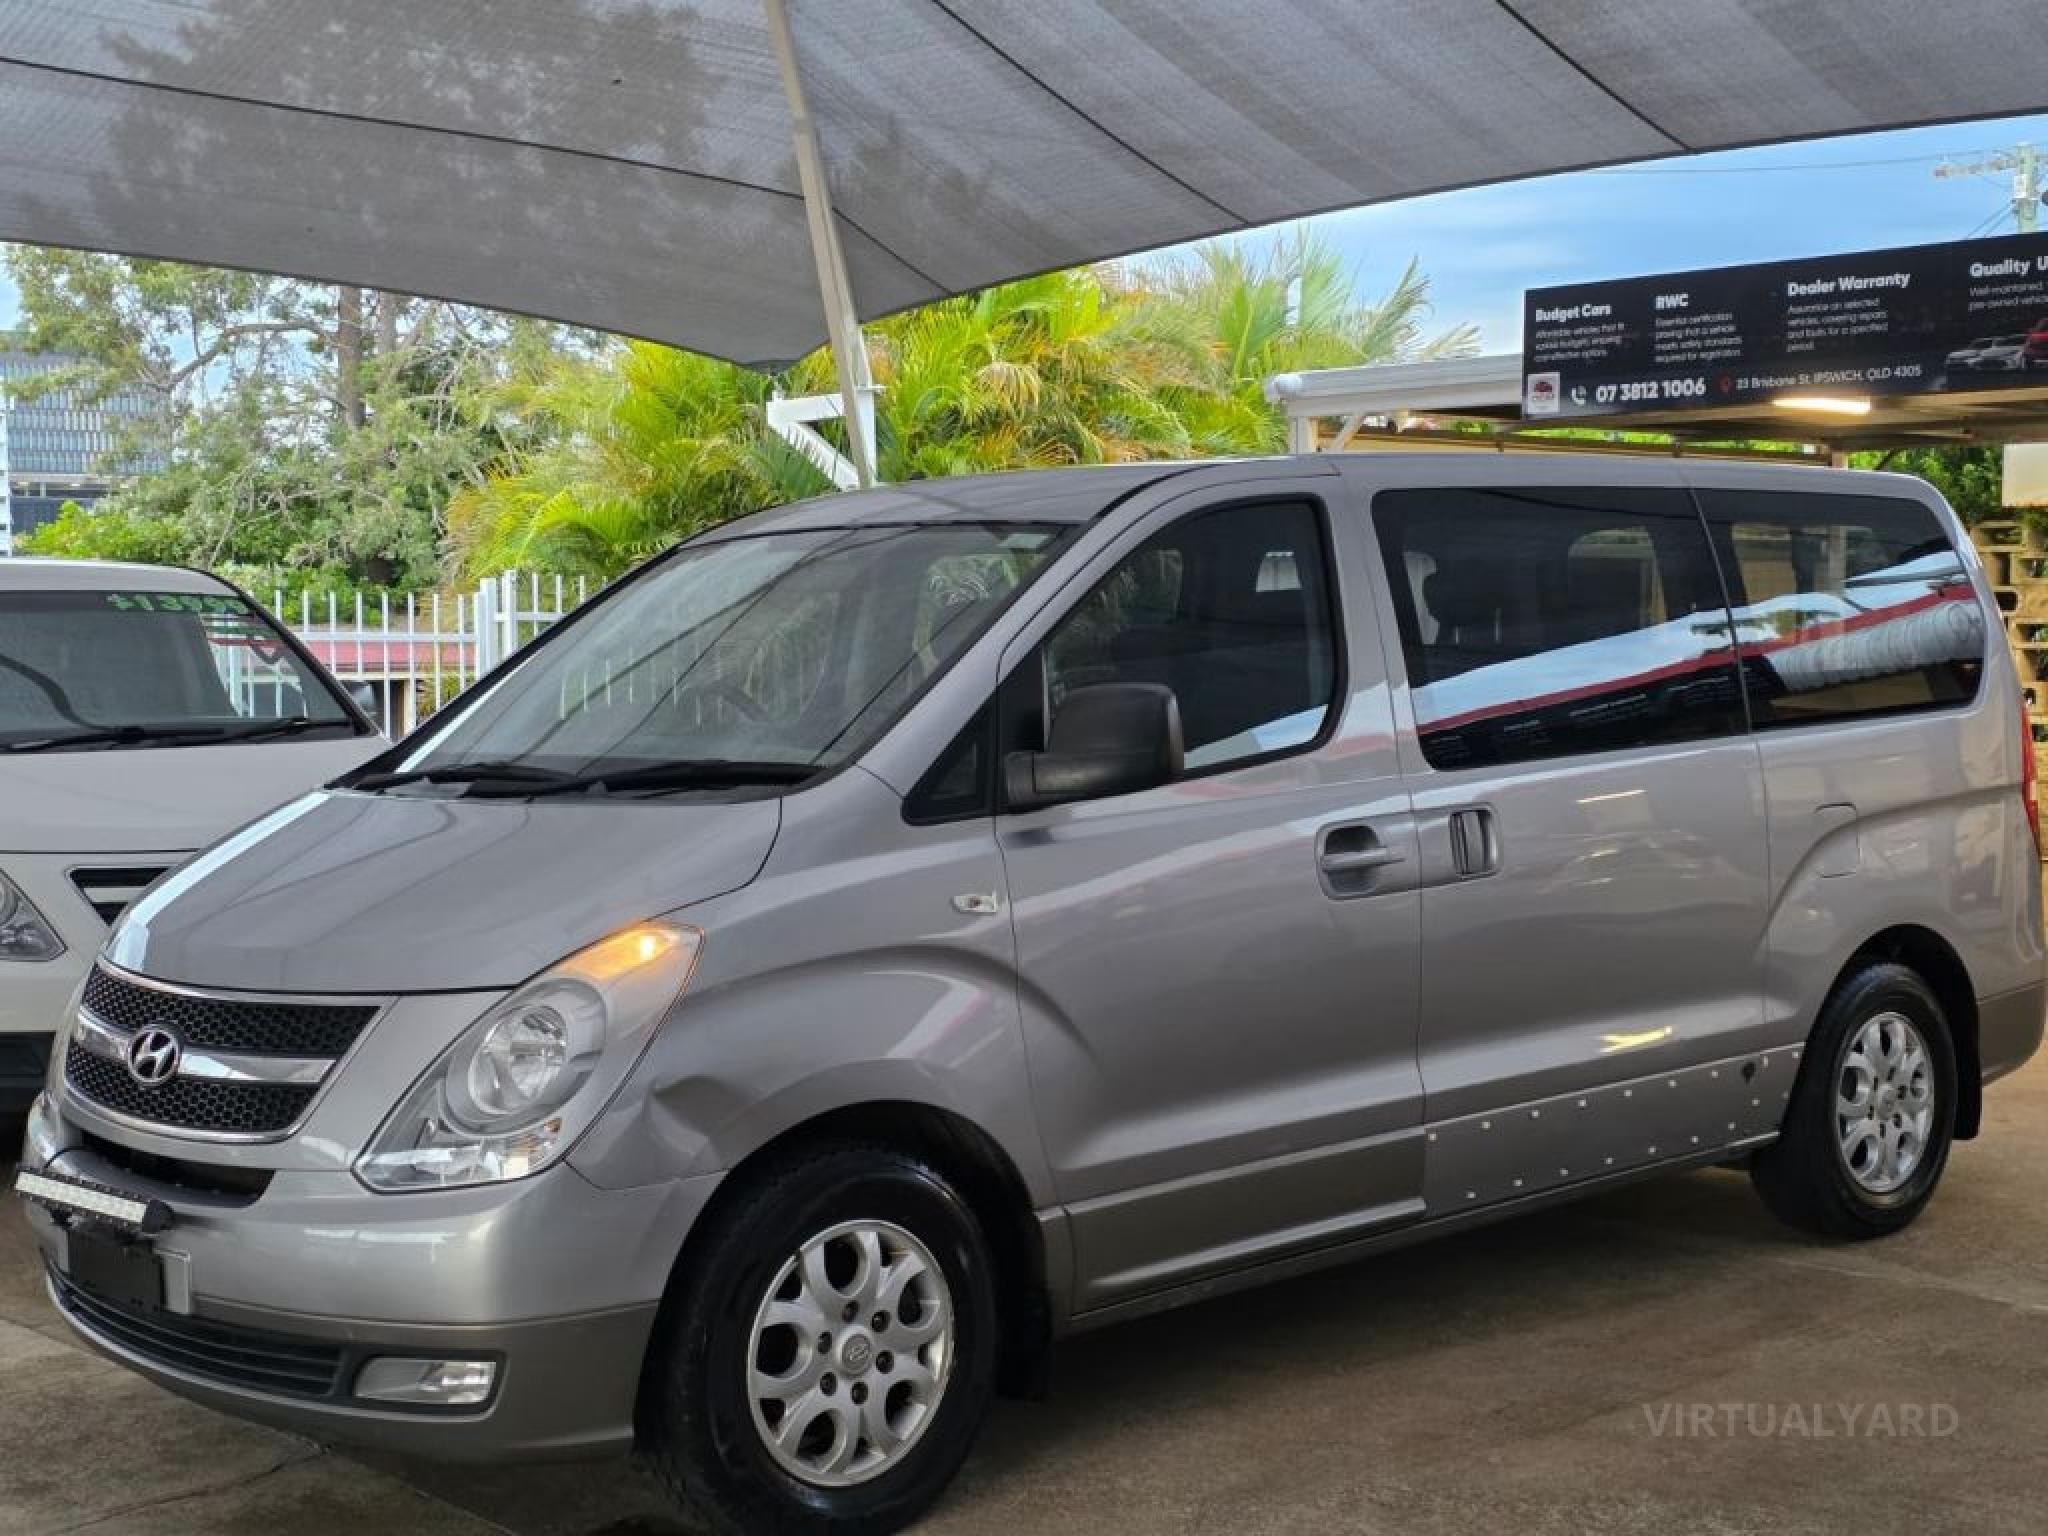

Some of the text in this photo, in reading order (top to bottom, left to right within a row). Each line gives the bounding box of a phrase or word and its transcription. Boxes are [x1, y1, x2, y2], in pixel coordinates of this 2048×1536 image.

[1970, 258, 2031, 278] Quality
[1787, 272, 1911, 296] Dealer Warranty
[1655, 293, 1689, 310] RWC
[1535, 303, 1612, 323] Budget Cars
[1596, 377, 1707, 404] 07 3812 1006
